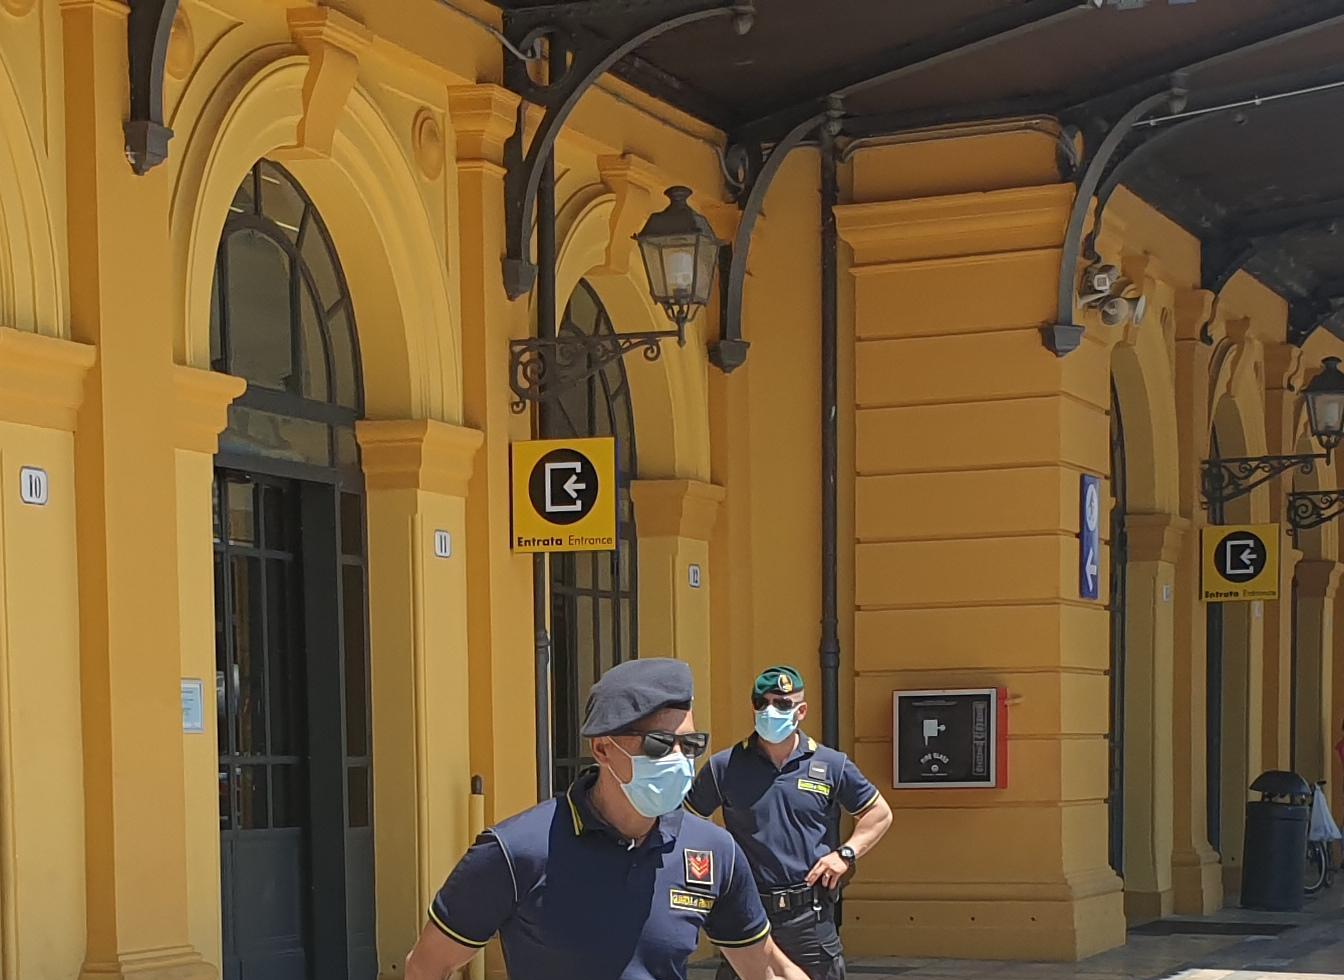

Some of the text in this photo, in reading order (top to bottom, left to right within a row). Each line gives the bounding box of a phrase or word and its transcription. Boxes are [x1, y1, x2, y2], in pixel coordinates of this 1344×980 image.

[29, 474, 42, 499] 10
[439, 534, 447, 553] 11
[517, 534, 613, 547] Entrata Entrance
[1205, 590, 1239, 599] Entrata
